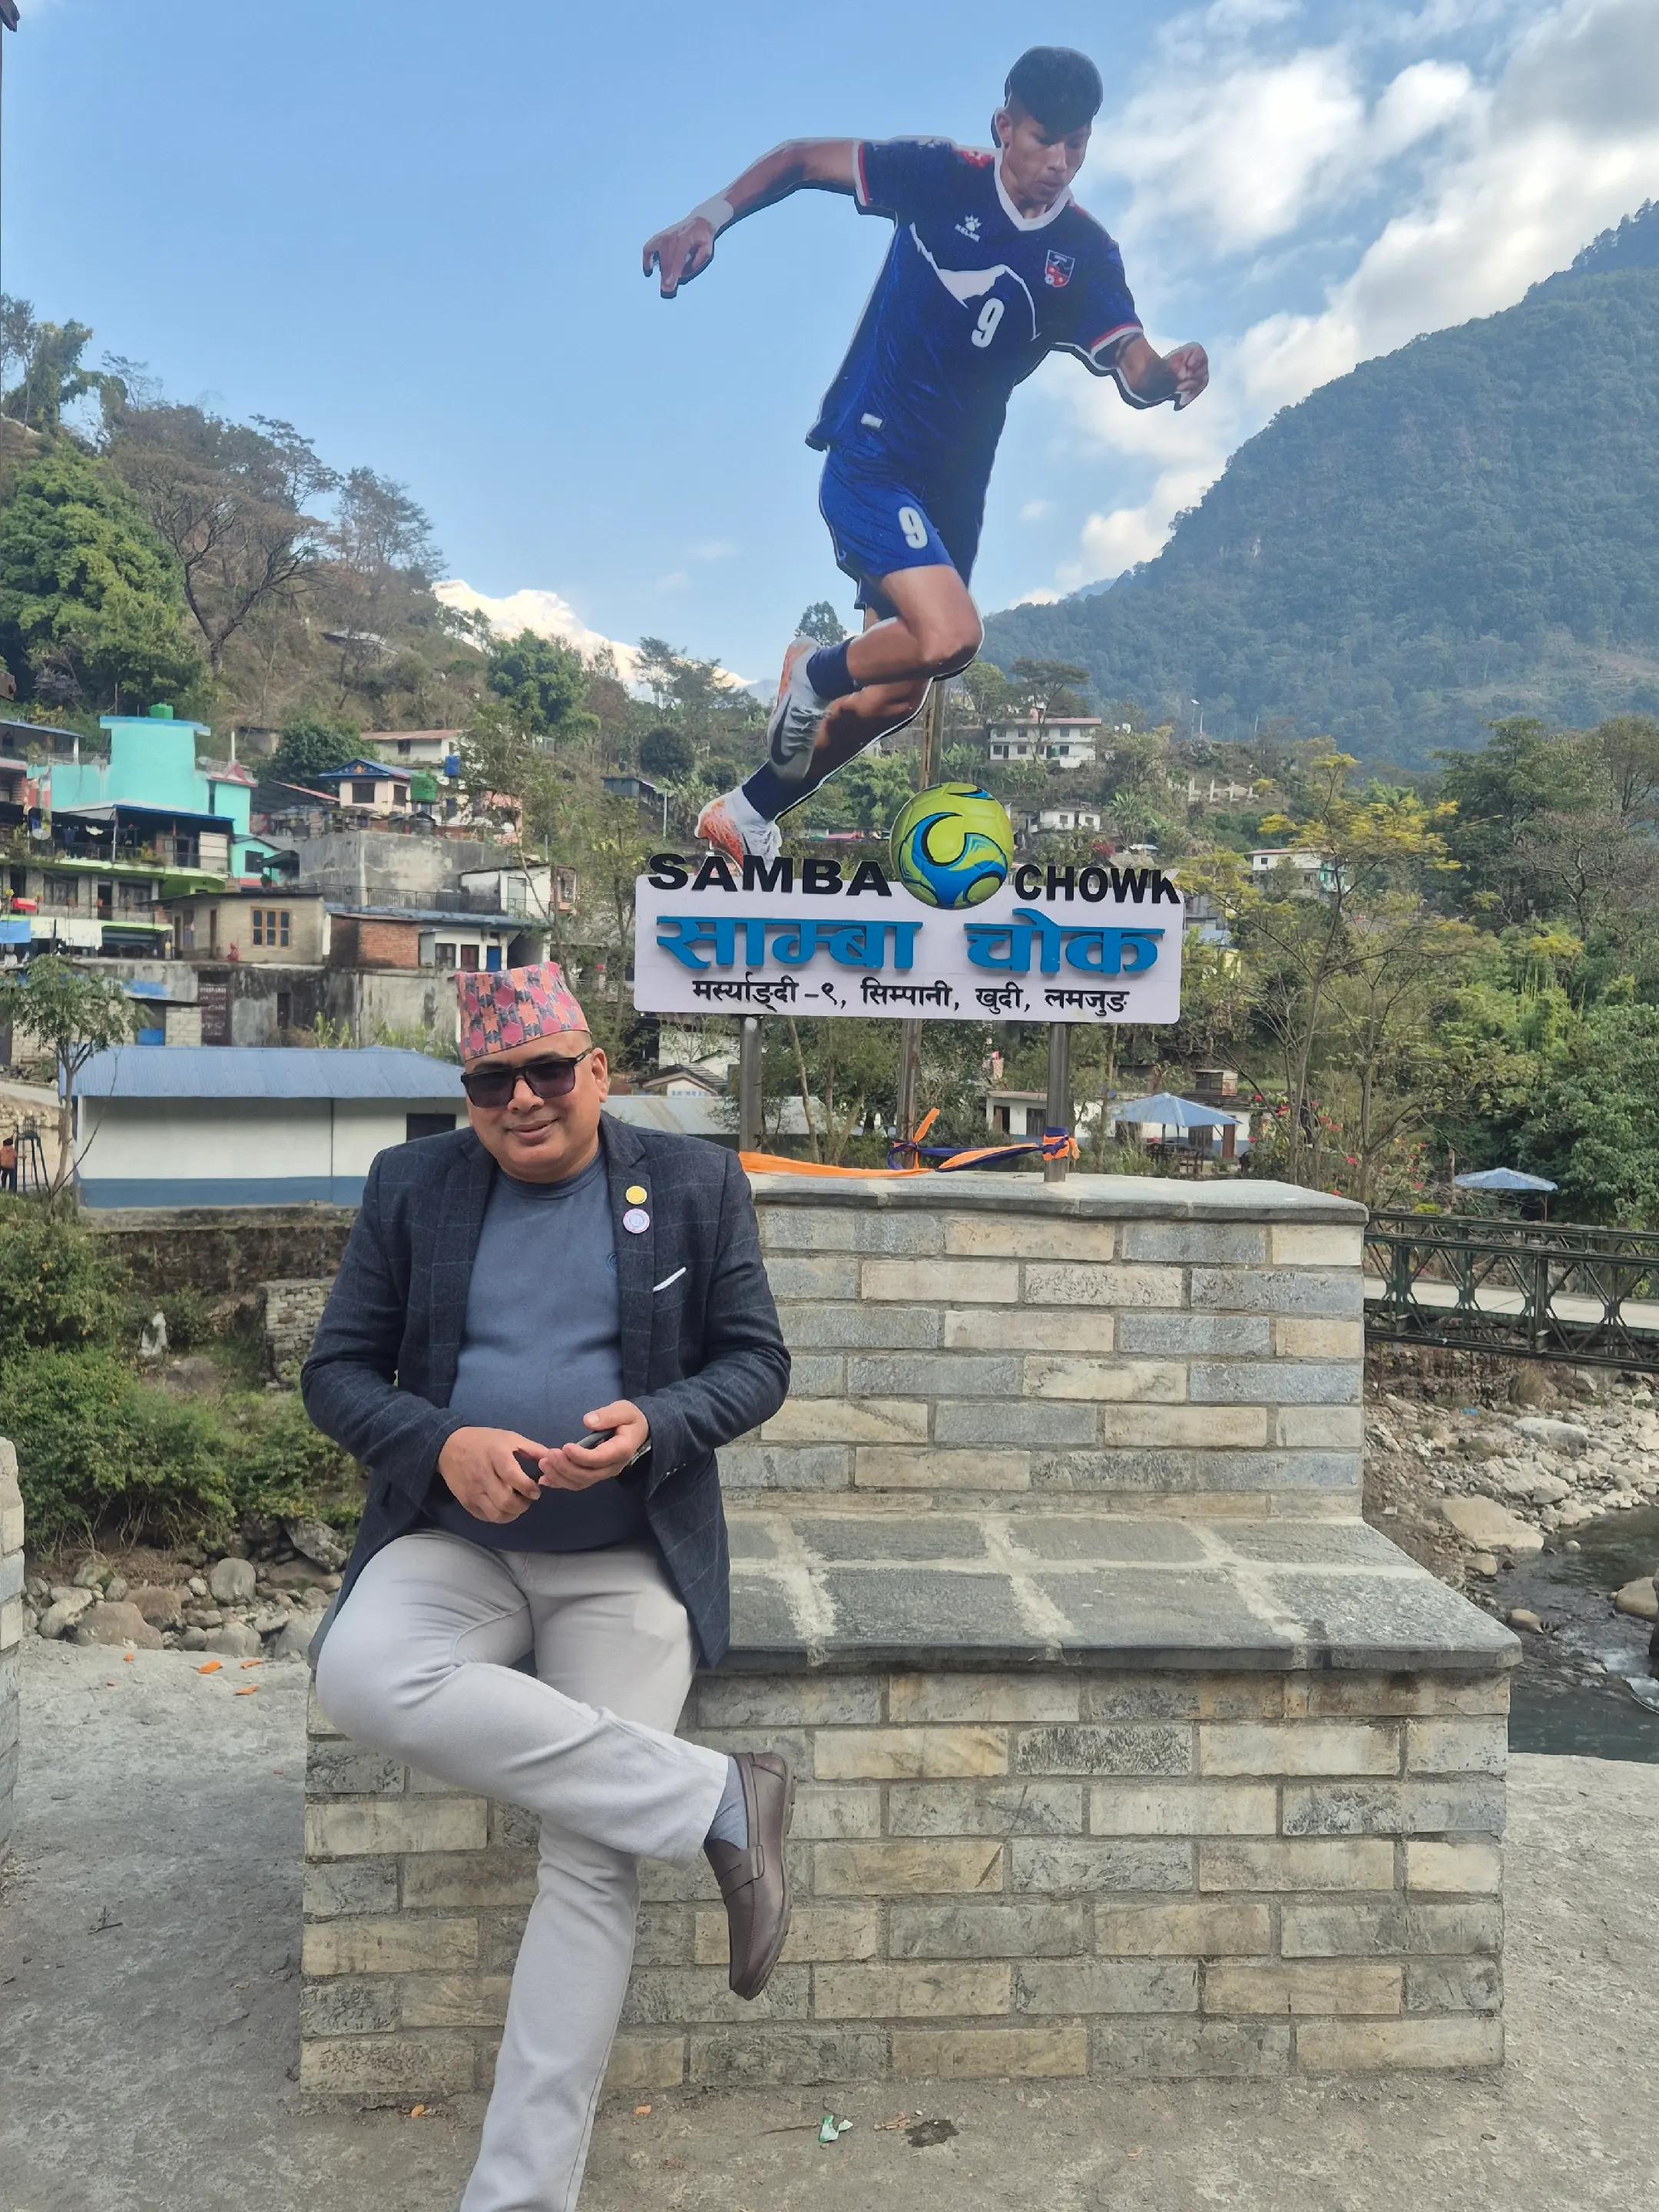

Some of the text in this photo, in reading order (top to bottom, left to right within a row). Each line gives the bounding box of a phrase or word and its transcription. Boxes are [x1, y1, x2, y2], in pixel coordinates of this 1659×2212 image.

[972, 298, 1004, 347] 9
[899, 507, 928, 548] 9
[648, 853, 1181, 904] SAMBA CHOWK
[657, 908, 1165, 974] साम्बा चोक
[1045, 988, 1131, 1016] लमजुङ
